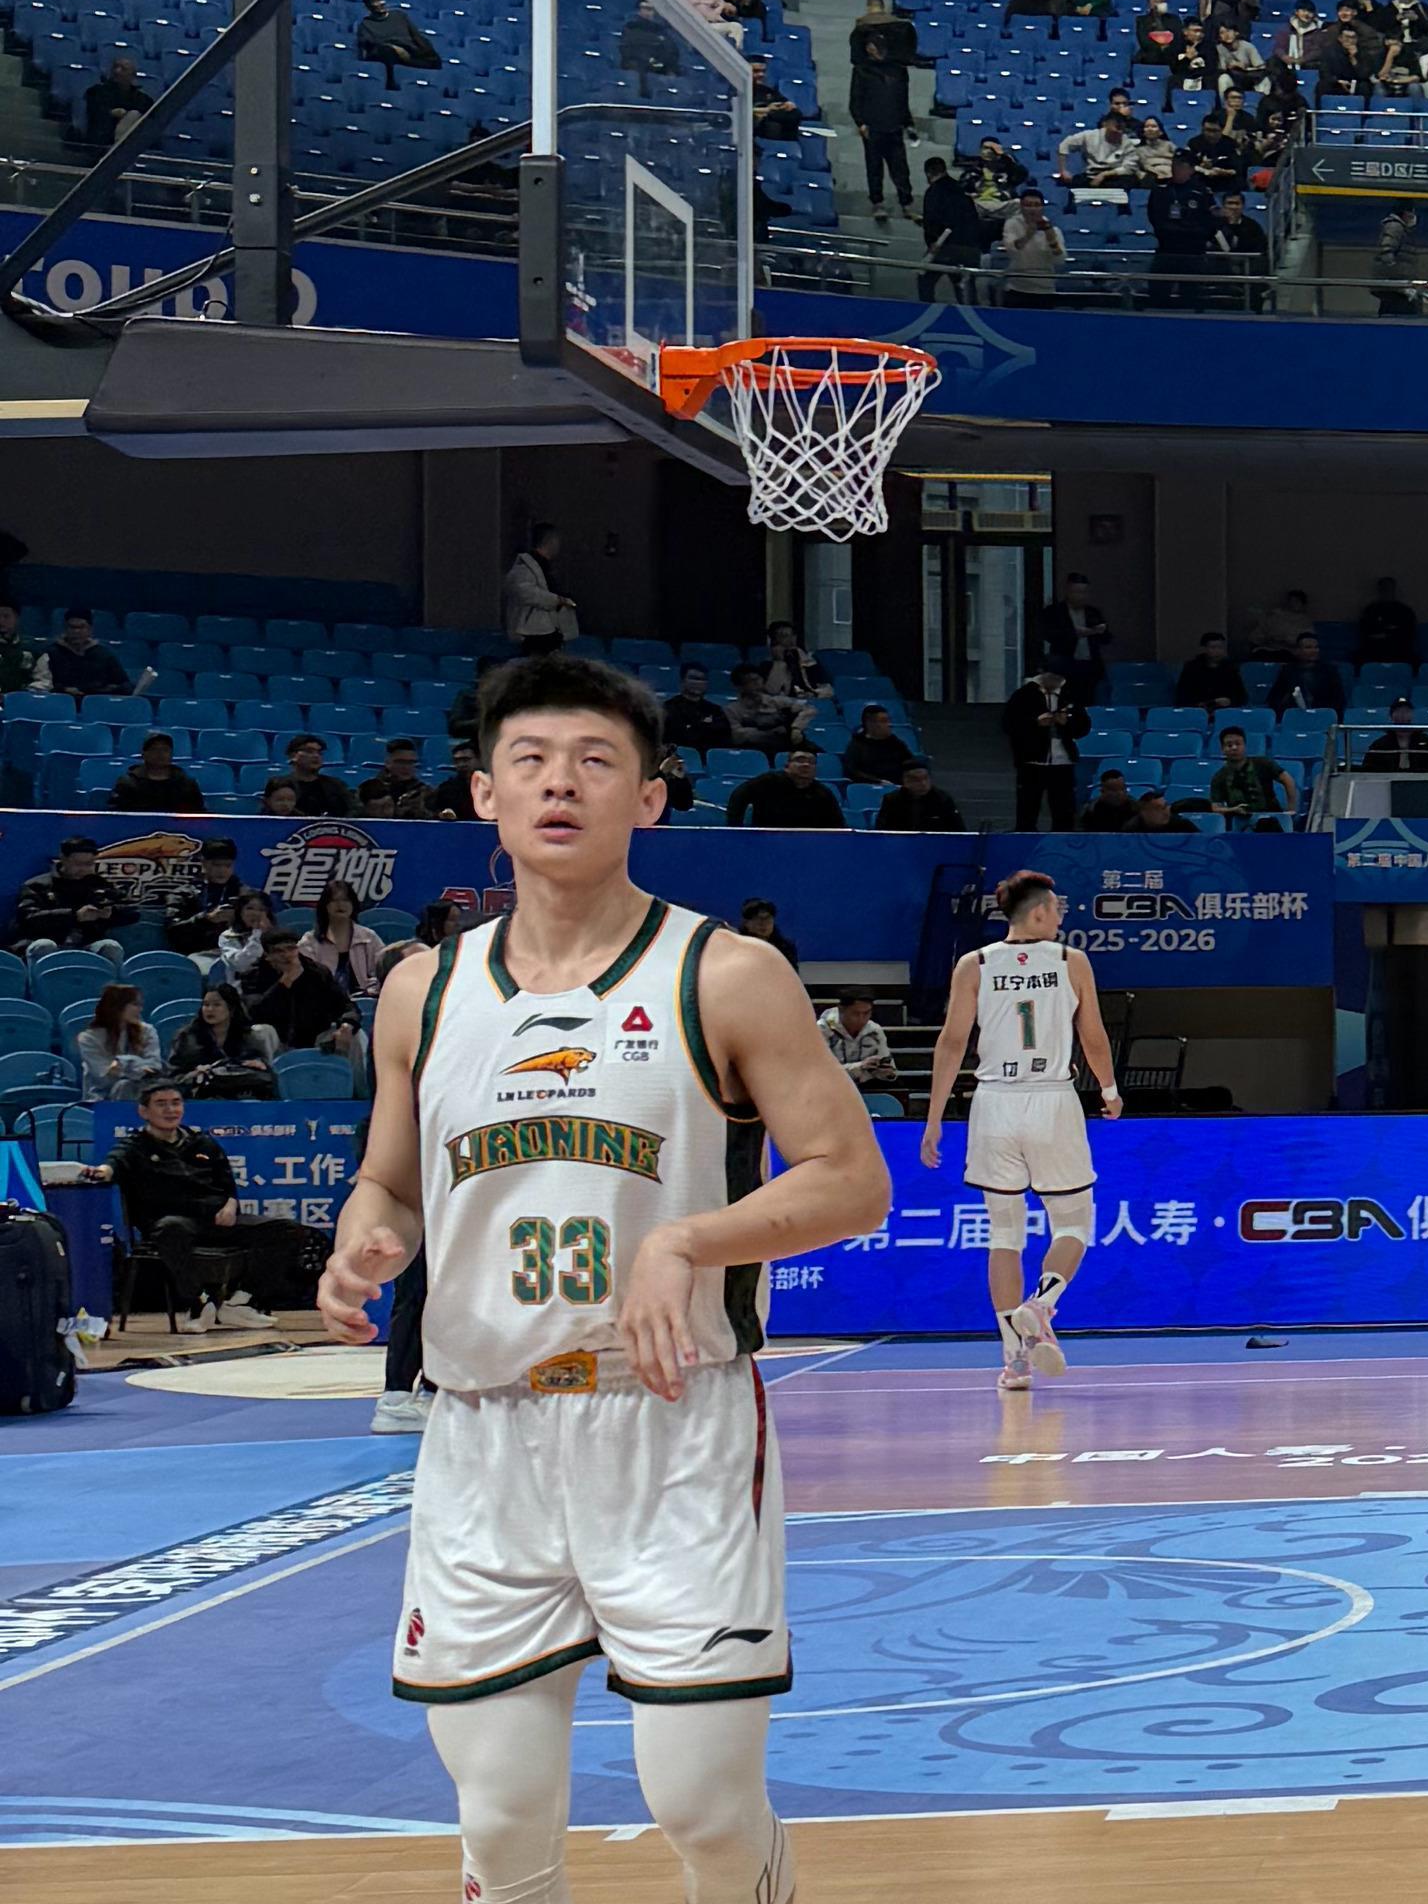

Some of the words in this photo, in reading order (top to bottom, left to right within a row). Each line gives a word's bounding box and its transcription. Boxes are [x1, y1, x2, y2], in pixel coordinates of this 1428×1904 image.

[95, 862, 202, 877] LEOPARD
[1102, 870, 1164, 889] 第二届
[1015, 998, 1037, 1051] 1
[445, 1115, 666, 1192] LIAONING
[509, 1215, 613, 1305] 33
